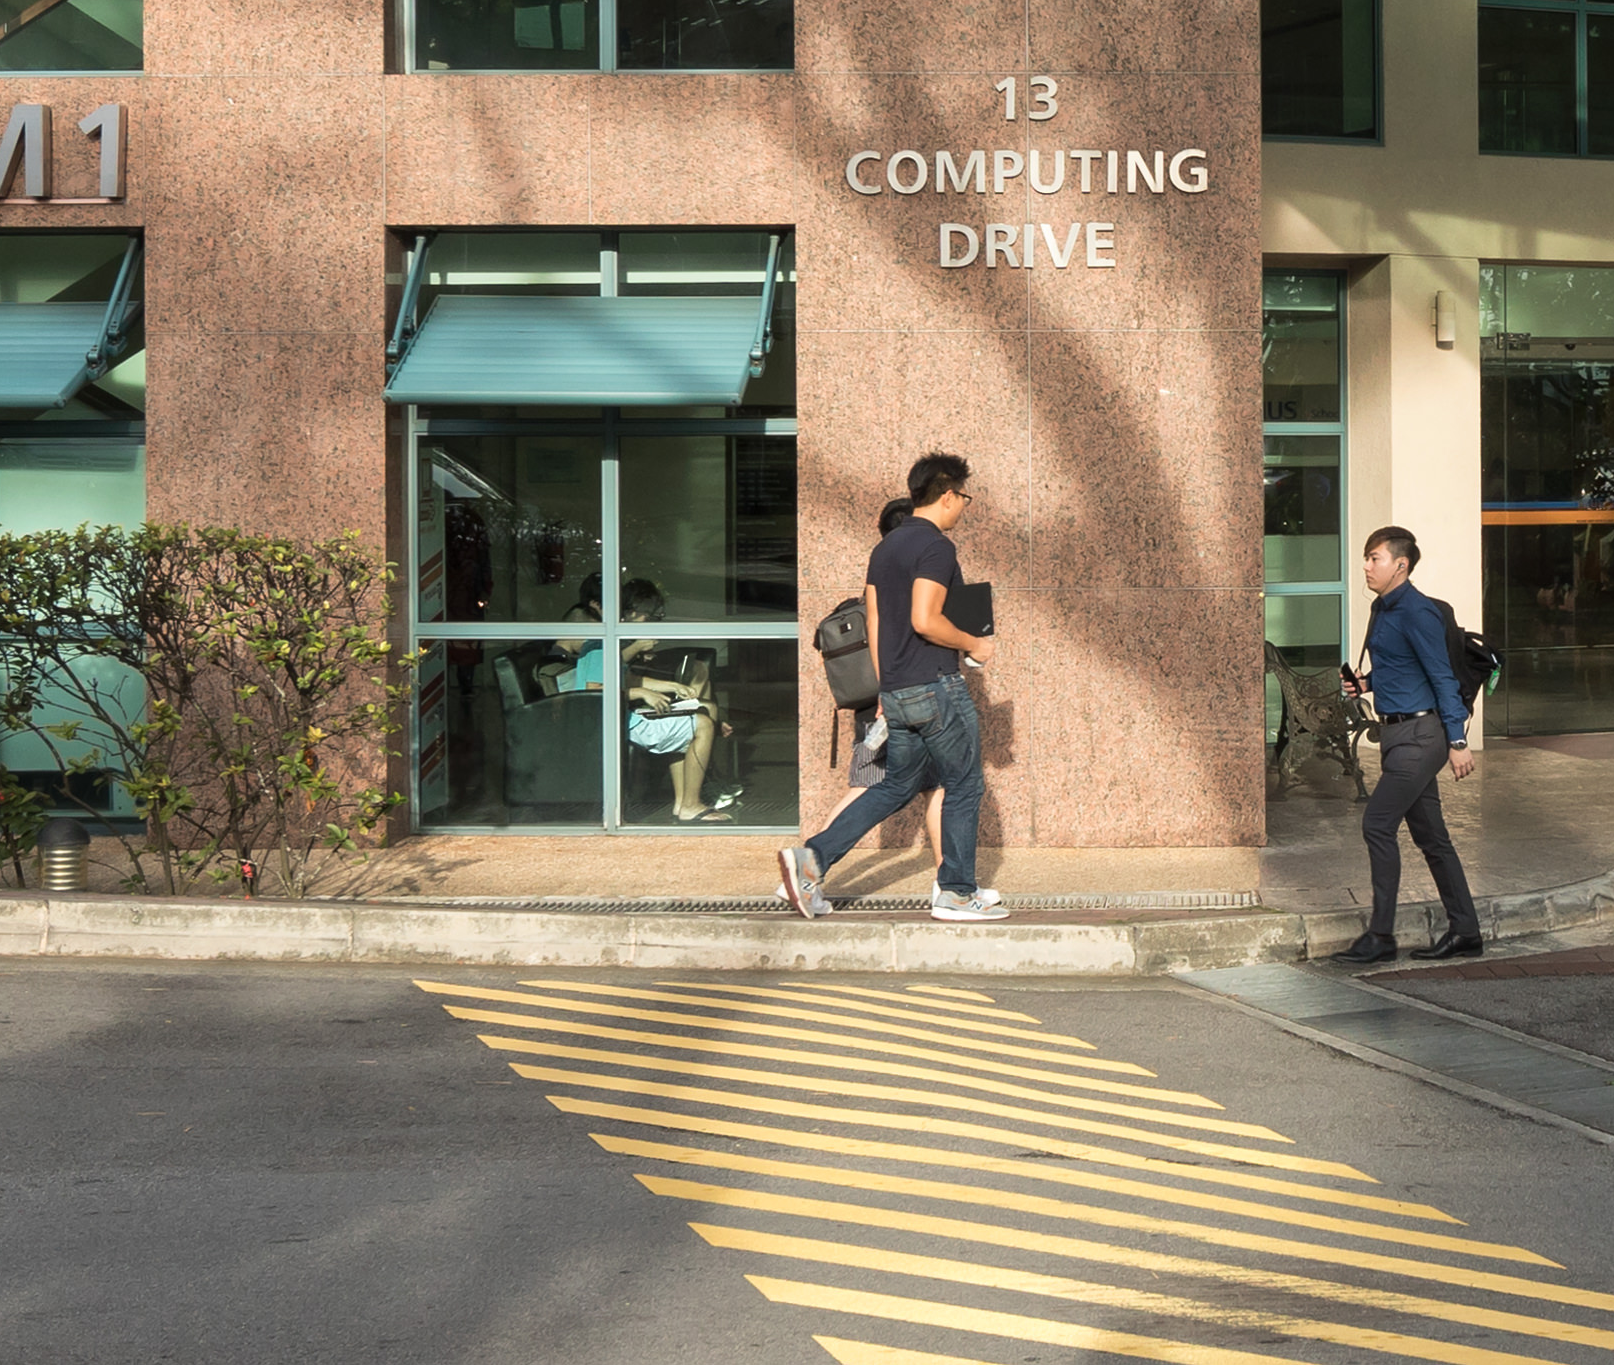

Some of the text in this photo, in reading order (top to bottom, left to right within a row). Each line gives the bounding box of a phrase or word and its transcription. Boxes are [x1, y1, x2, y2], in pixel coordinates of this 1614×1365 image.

[995, 75, 1059, 121] 13
[845, 148, 1209, 196] COMPUTING
[939, 222, 1117, 269] DRIVE
[1265, 401, 1298, 420] US
